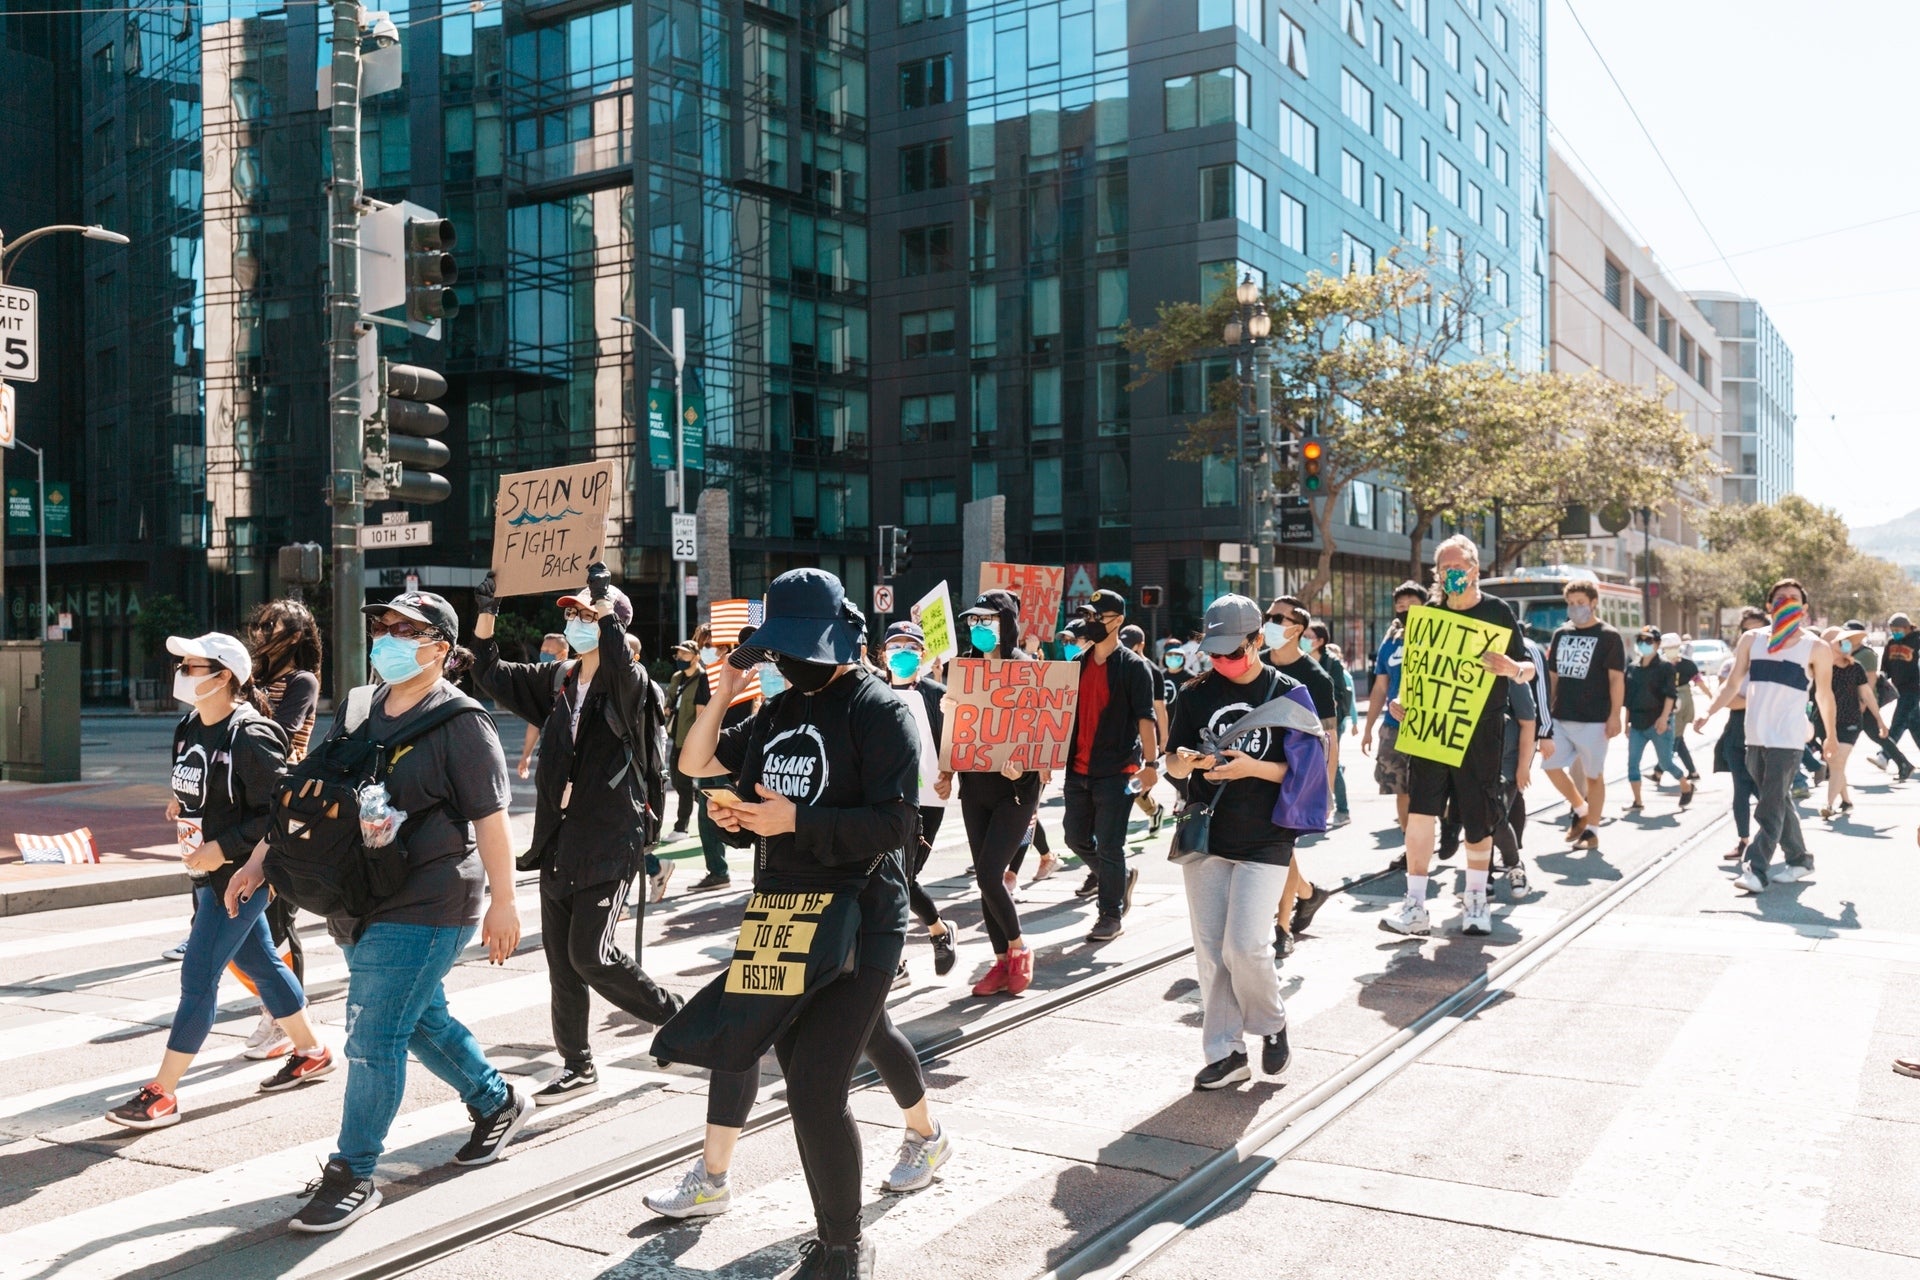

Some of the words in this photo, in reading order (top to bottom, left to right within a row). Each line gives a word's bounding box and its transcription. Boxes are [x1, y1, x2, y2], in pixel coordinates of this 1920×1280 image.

[0, 337, 30, 373] 5
[502, 476, 572, 517] STAN
[582, 471, 608, 506] UP
[372, 530, 397, 543] 10TH
[405, 528, 417, 540] ST
[675, 518, 694, 526] SPEED
[504, 529, 570, 563] FIGHT
[676, 539, 694, 556] 25
[990, 562, 1063, 587] THEY
[1408, 617, 1500, 659] UNITY
[957, 659, 1051, 694] THEY
[1403, 647, 1485, 688] AGAINST
[990, 685, 1077, 709] CAN'T
[1405, 675, 1473, 715] HATE
[952, 704, 1072, 744] BURN
[763, 753, 817, 776] ASIANS
[950, 743, 993, 771] US
[1008, 743, 1066, 770] ALL
[762, 773, 811, 798] BELONG
[753, 924, 773, 948] TO
[773, 925, 795, 949] BE
[742, 964, 787, 991] ASIAN
